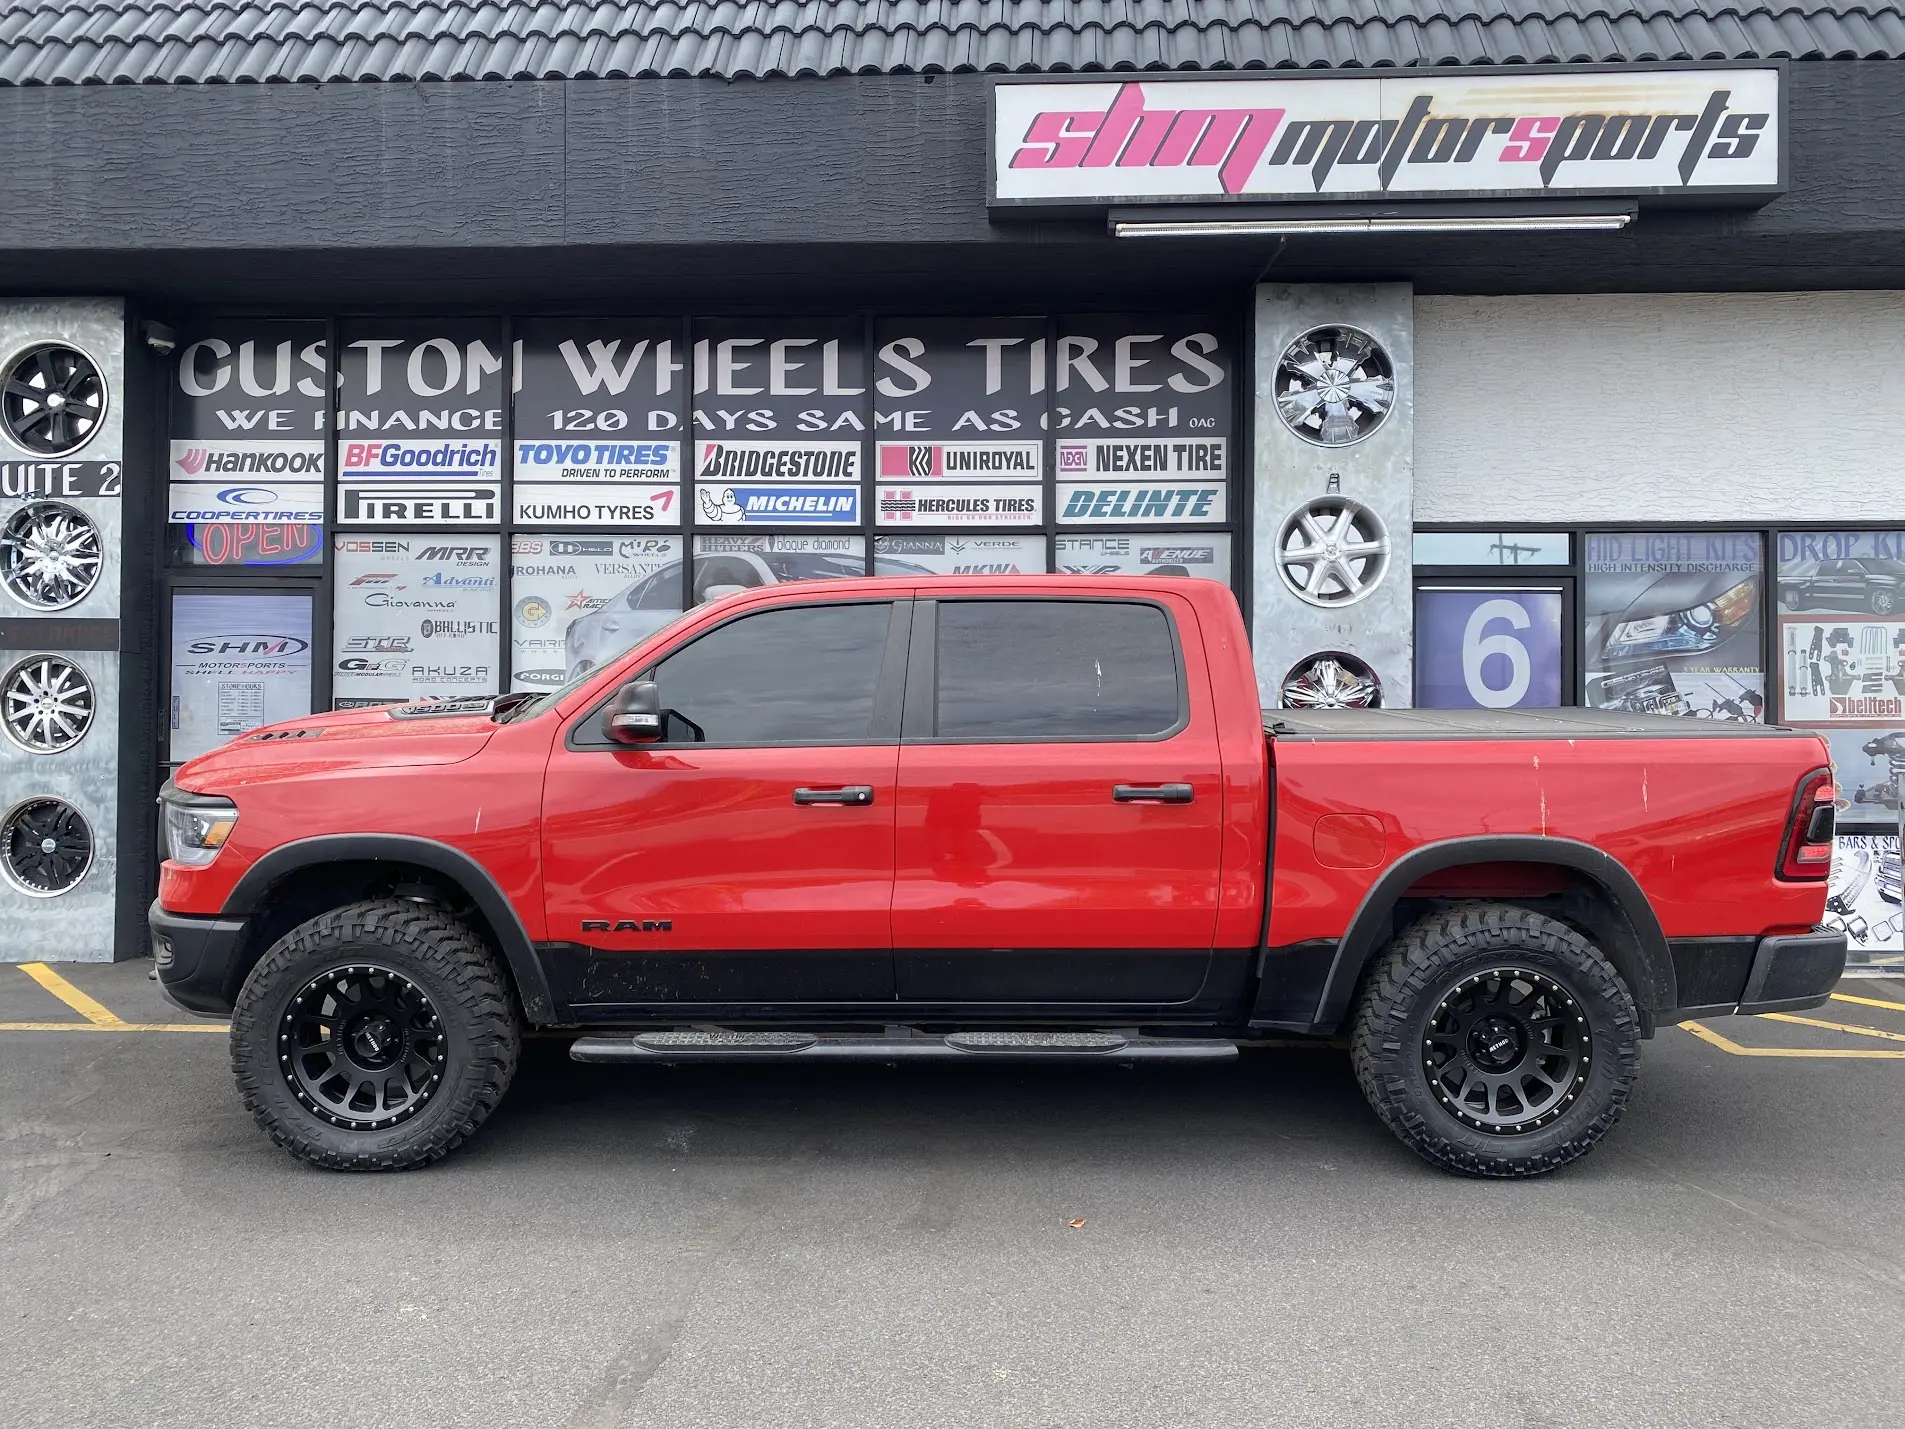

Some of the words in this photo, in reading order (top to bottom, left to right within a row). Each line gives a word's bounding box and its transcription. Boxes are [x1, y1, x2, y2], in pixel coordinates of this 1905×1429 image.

[1269, 90, 1770, 190] motorsports
[178, 337, 523, 397] CUSTOM
[557, 336, 932, 397] WHEELS
[966, 332, 1225, 395] TIRES
[215, 409, 295, 431] WE
[315, 409, 502, 431] FINANCE
[546, 409, 628, 431] 120
[648, 409, 777, 431] DAYS
[809, 408, 932, 431] SAME
[952, 407, 1021, 431] AS
[1040, 405, 1178, 430] CASH
[344, 444, 497, 468] BFGoodrich
[519, 445, 593, 465] TOYO
[593, 445, 669, 465] TIRES
[702, 444, 856, 477] BRIDGESTONE
[946, 451, 1035, 470] UNIROYAL
[1096, 444, 1167, 471] NEXEN
[1173, 444, 1222, 471] TIRE
[1, 464, 83, 496] UITE
[98, 462, 121, 496] 2
[478, 469, 493, 477] Tires
[561, 468, 601, 478] DRIVEN
[604, 468, 616, 478] TO
[620, 468, 670, 478] PERFORM
[344, 489, 495, 519] PIRELLI
[746, 496, 853, 512] MICHELIN
[918, 499, 990, 513] HERCULES
[993, 499, 1034, 512] TIRES
[1062, 490, 1218, 518] DELINTE
[519, 505, 591, 520] KUMHO
[595, 505, 654, 520] TYRES
[203, 523, 307, 564] OPEN
[335, 542, 409, 552] VOSSEN
[702, 544, 763, 552] HITTERS
[813, 537, 850, 550] diamond
[1056, 539, 1130, 550] STANCE
[1587, 535, 1621, 561] HID
[1631, 534, 1697, 561] LIGHT
[1702, 534, 1757, 561] KITS
[1780, 533, 1859, 561] DROP
[1873, 533, 1902, 560] KI
[414, 547, 491, 560] MRR
[516, 566, 576, 575] ROHANA
[1588, 563, 1618, 572] HIGH
[1620, 563, 1683, 572] INTENSITY
[1686, 563, 1755, 572] DISCHARGE
[423, 573, 496, 585] Advanti
[365, 593, 455, 608] Giovanna
[434, 621, 498, 634] BALLISTIC
[187, 640, 289, 655] SHM
[1462, 598, 1531, 708] 6
[412, 666, 487, 675] AKUZA
[1848, 697, 1901, 713] belltech
[1839, 836, 1867, 849] BARS
[1871, 836, 1878, 849] &
[582, 920, 672, 931] RAM
